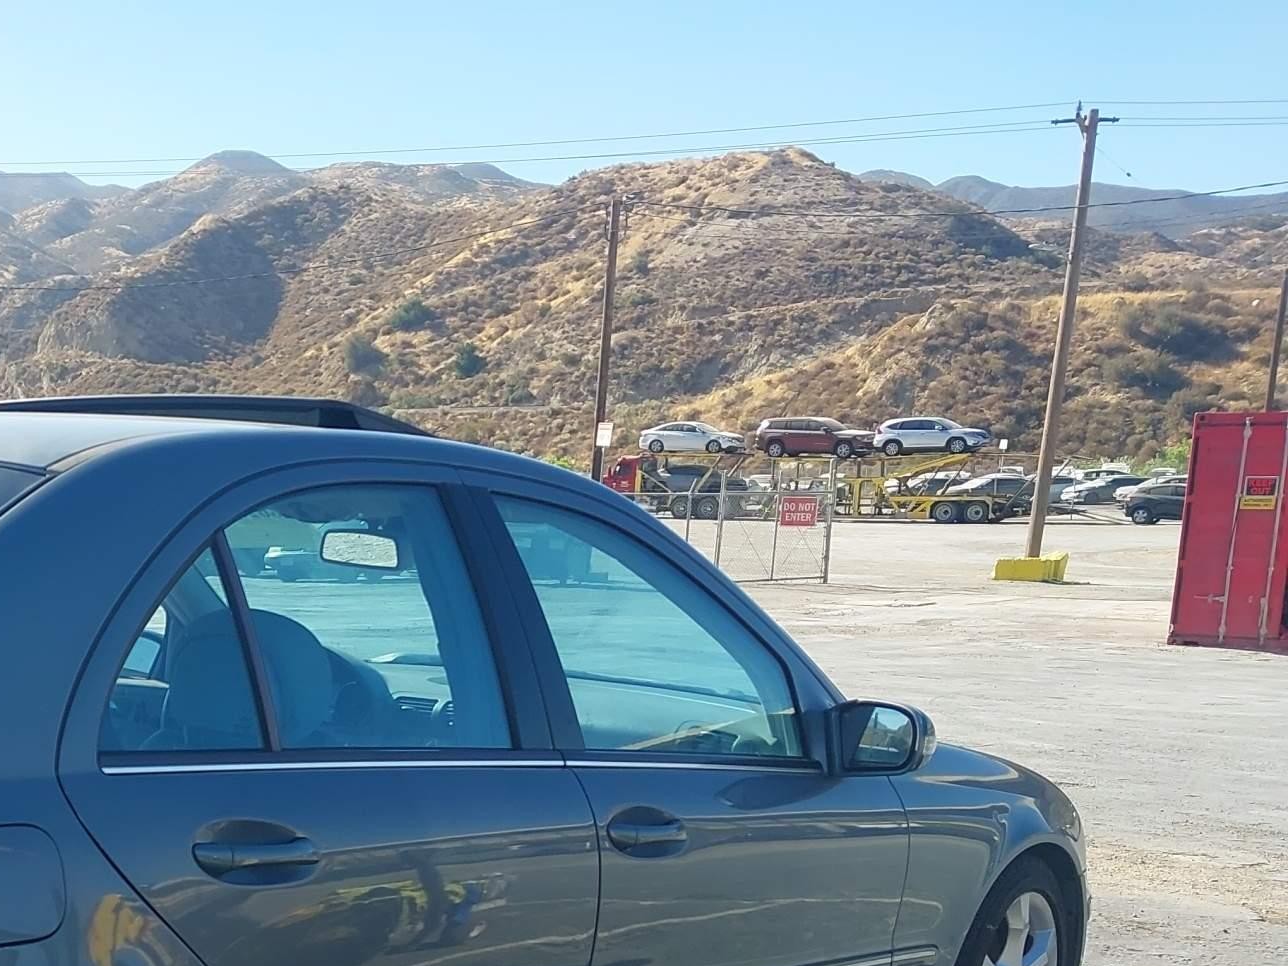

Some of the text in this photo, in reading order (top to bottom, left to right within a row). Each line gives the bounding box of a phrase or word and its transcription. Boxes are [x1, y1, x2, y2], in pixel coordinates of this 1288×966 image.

[1249, 479, 1275, 487] KEEP
[784, 502, 816, 512] DO NOT
[785, 513, 812, 522] ENTER
